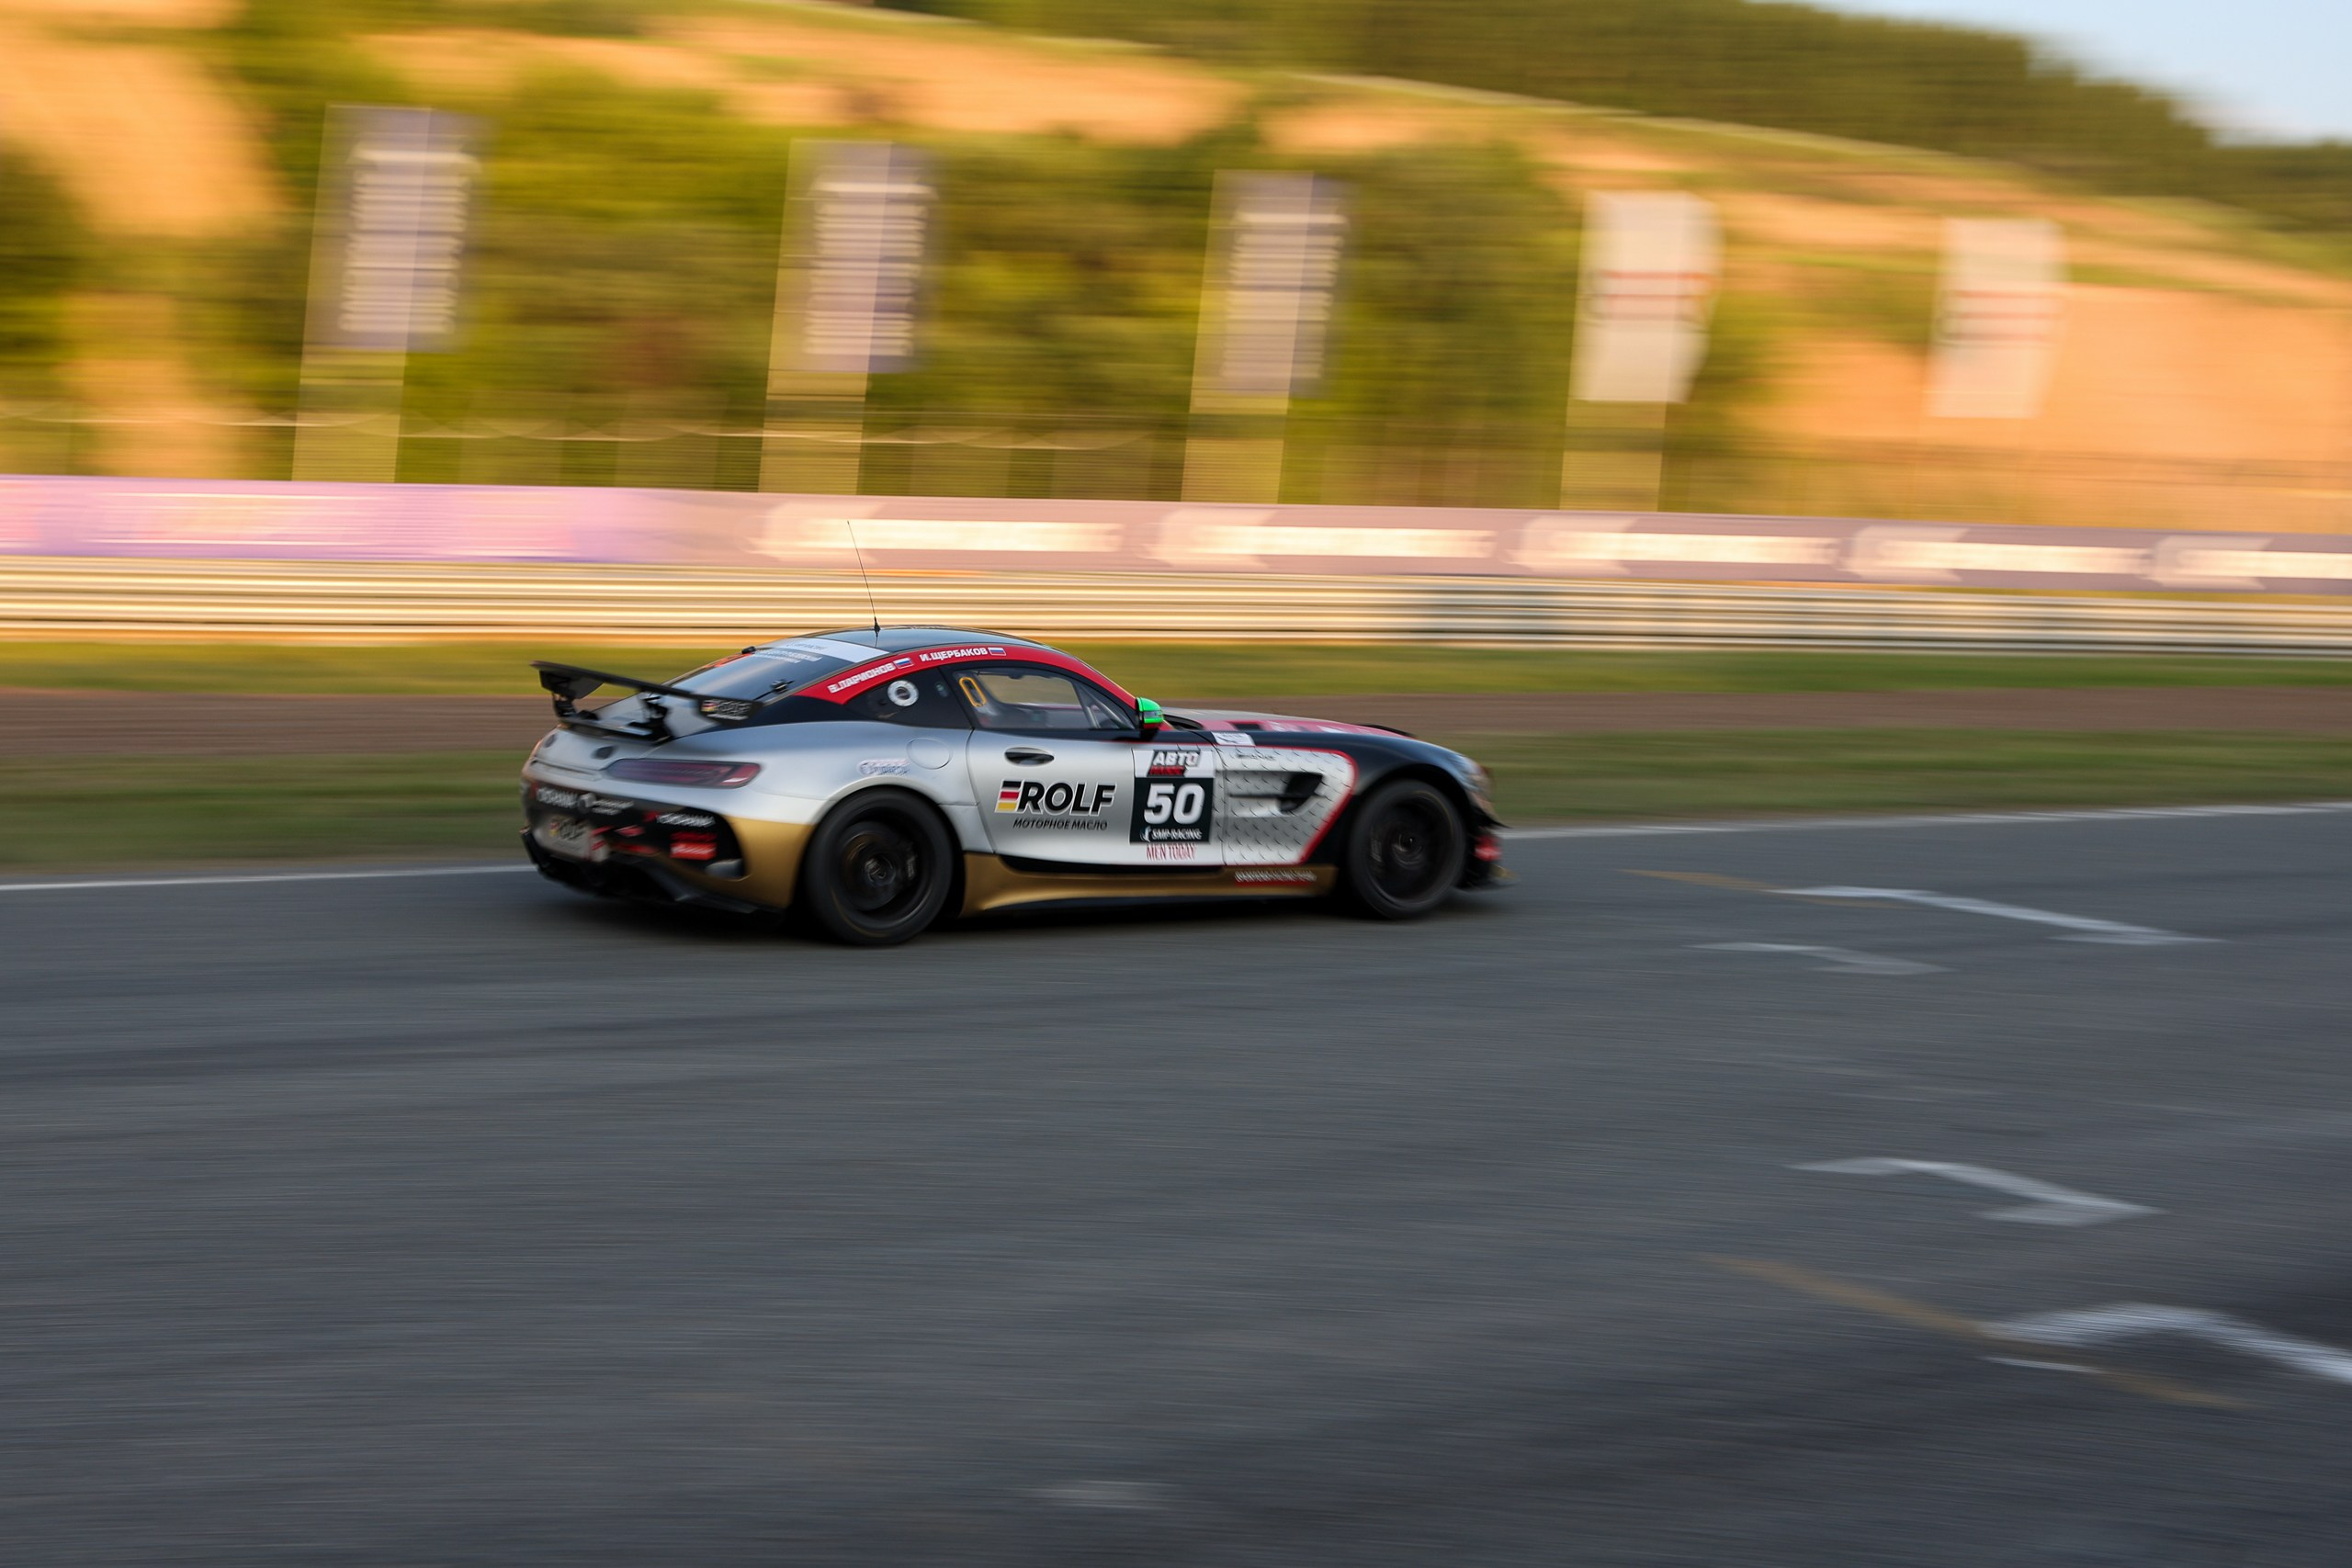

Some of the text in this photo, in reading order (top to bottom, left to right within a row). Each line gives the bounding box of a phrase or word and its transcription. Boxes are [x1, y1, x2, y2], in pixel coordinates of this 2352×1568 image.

[920, 648, 989, 661] И.ЩЕРБАКОВ
[1152, 750, 1199, 766] АВТО
[1017, 781, 1116, 814] ROLF
[1143, 783, 1205, 825] 50
[1012, 818, 1108, 831] МОТОРНОЕ МАСЛО
